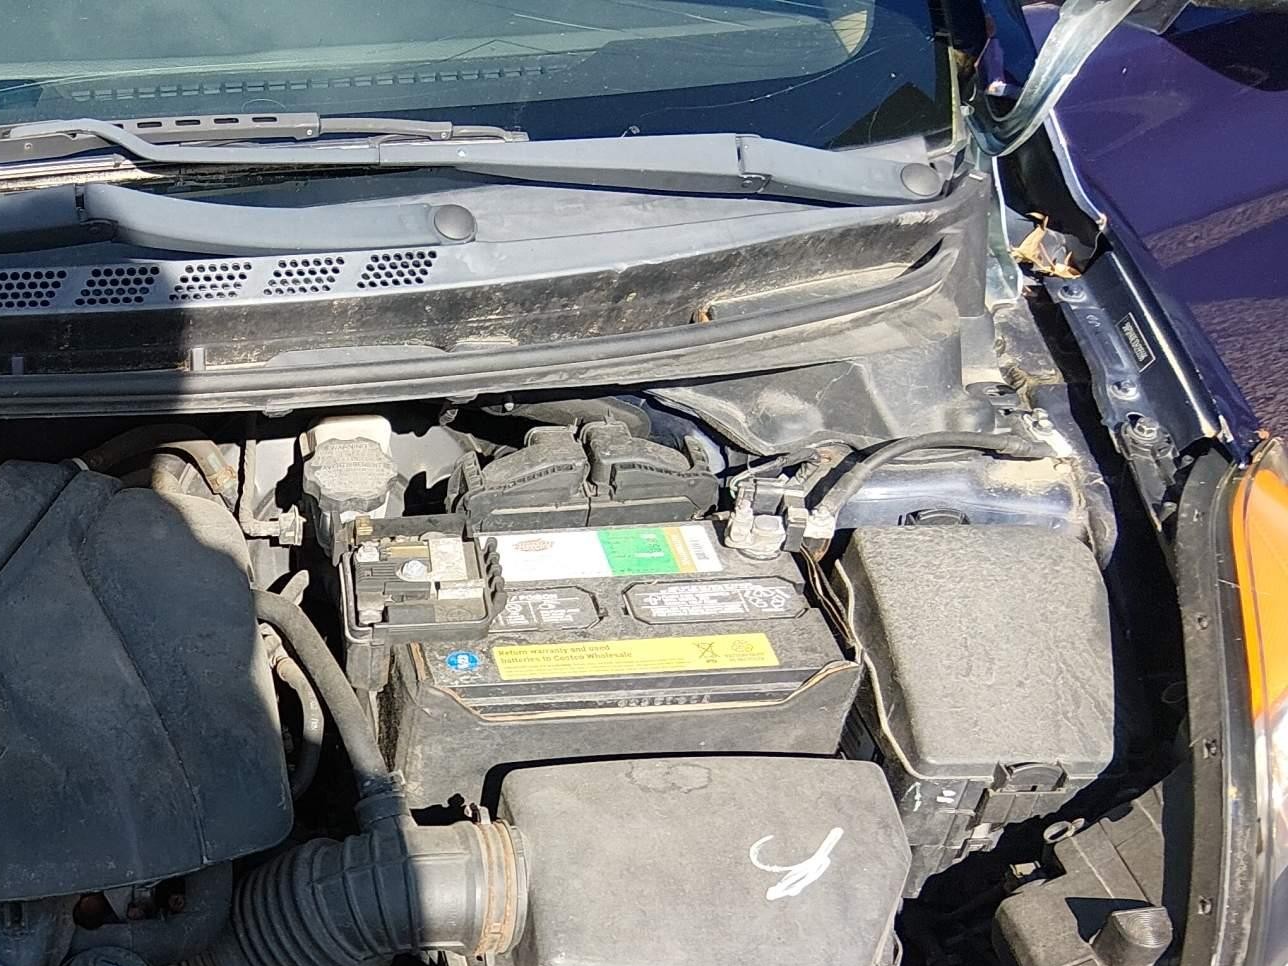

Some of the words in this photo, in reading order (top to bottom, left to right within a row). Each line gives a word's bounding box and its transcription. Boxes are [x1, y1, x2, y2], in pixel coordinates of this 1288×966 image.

[498, 648, 528, 657] Return
[530, 646, 569, 656] warranty
[570, 645, 587, 653] and
[589, 644, 610, 652] used
[500, 655, 541, 664] batteries
[554, 653, 585, 662] Costco
[586, 651, 633, 660] Wholesale
